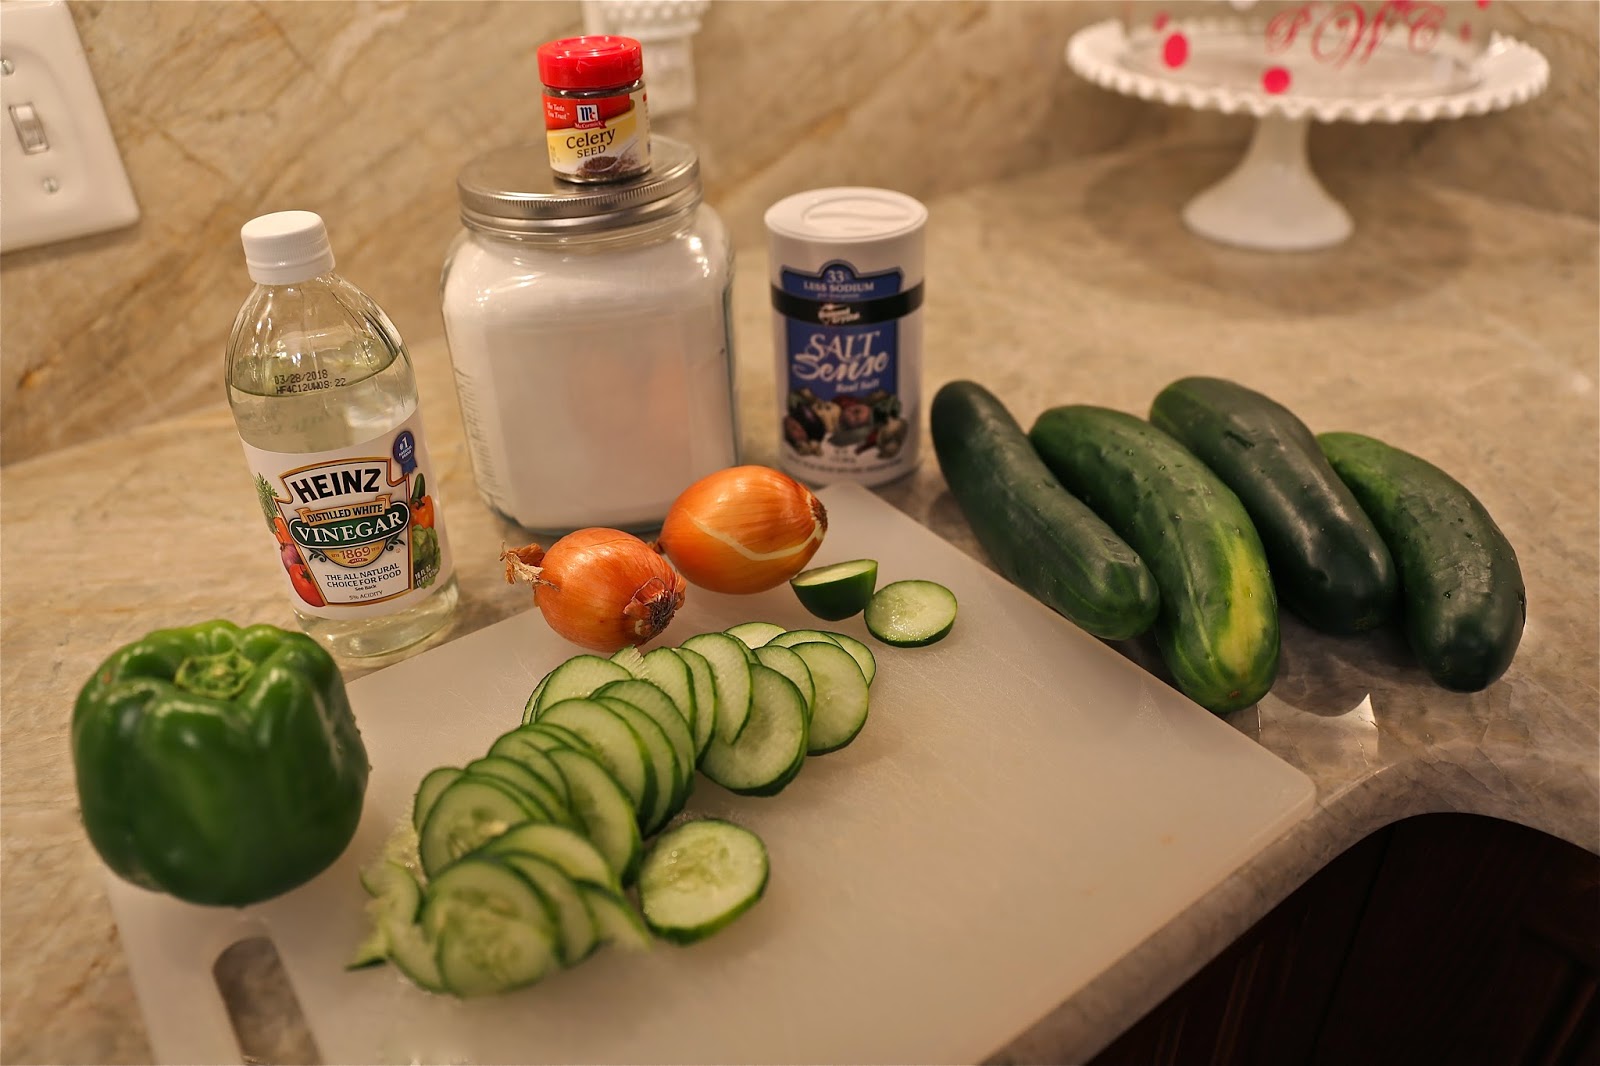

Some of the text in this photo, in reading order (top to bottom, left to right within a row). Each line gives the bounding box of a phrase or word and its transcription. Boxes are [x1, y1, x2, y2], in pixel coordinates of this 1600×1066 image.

[566, 128, 616, 149] Celery
[577, 145, 606, 158] SEED
[829, 282, 875, 293] SODIUM
[809, 331, 881, 360] SALT
[792, 351, 889, 381] Sense
[274, 369, 328, 385] 03/28/2018
[335, 377, 346, 387] 22
[290, 468, 382, 504] HEINZ
[308, 503, 383, 524] DISTILLED WHITE
[296, 510, 404, 544] VINEGAR
[340, 546, 371, 560] 1869
[327, 569, 402, 588] CHOICE FOR FOOD
[360, 563, 400, 578] NATURAL
[360, 590, 383, 600] ACIDITY
